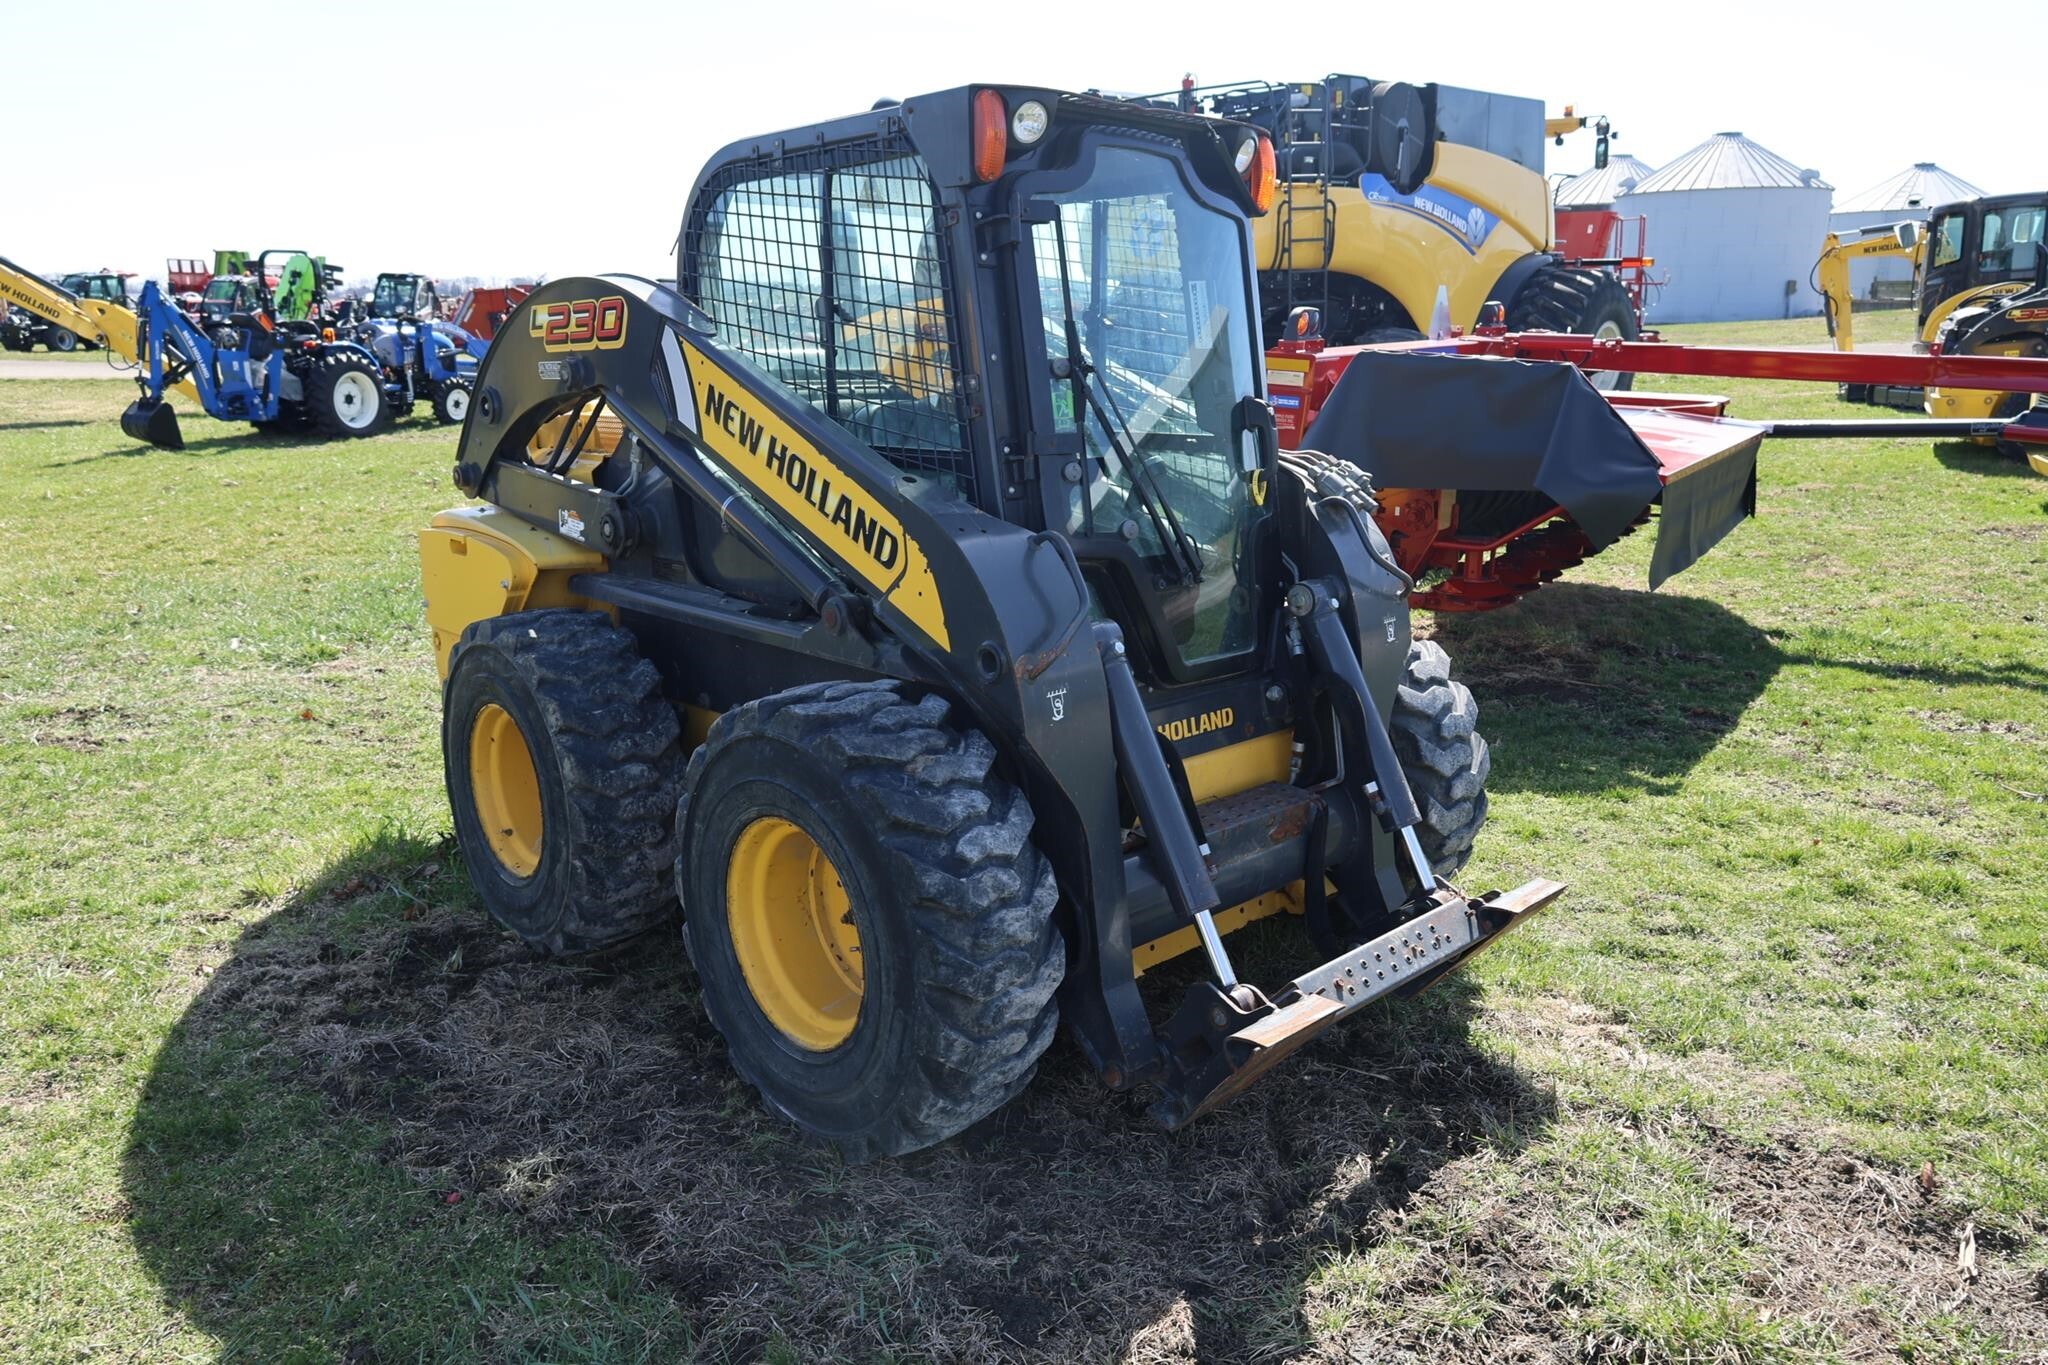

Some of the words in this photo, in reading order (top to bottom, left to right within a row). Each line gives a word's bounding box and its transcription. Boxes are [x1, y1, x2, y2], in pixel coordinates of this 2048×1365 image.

[1414, 196, 1434, 213] NEW
[1433, 204, 1467, 233] HOLLAND
[12, 289, 60, 319] HOLLAND
[530, 297, 627, 352] L230
[183, 330, 195, 348] NEW
[192, 346, 211, 379] HOLLAND
[705, 384, 763, 456] NEW
[766, 435, 899, 570] HOLLAND
[1157, 707, 1234, 742] HOLLAND
